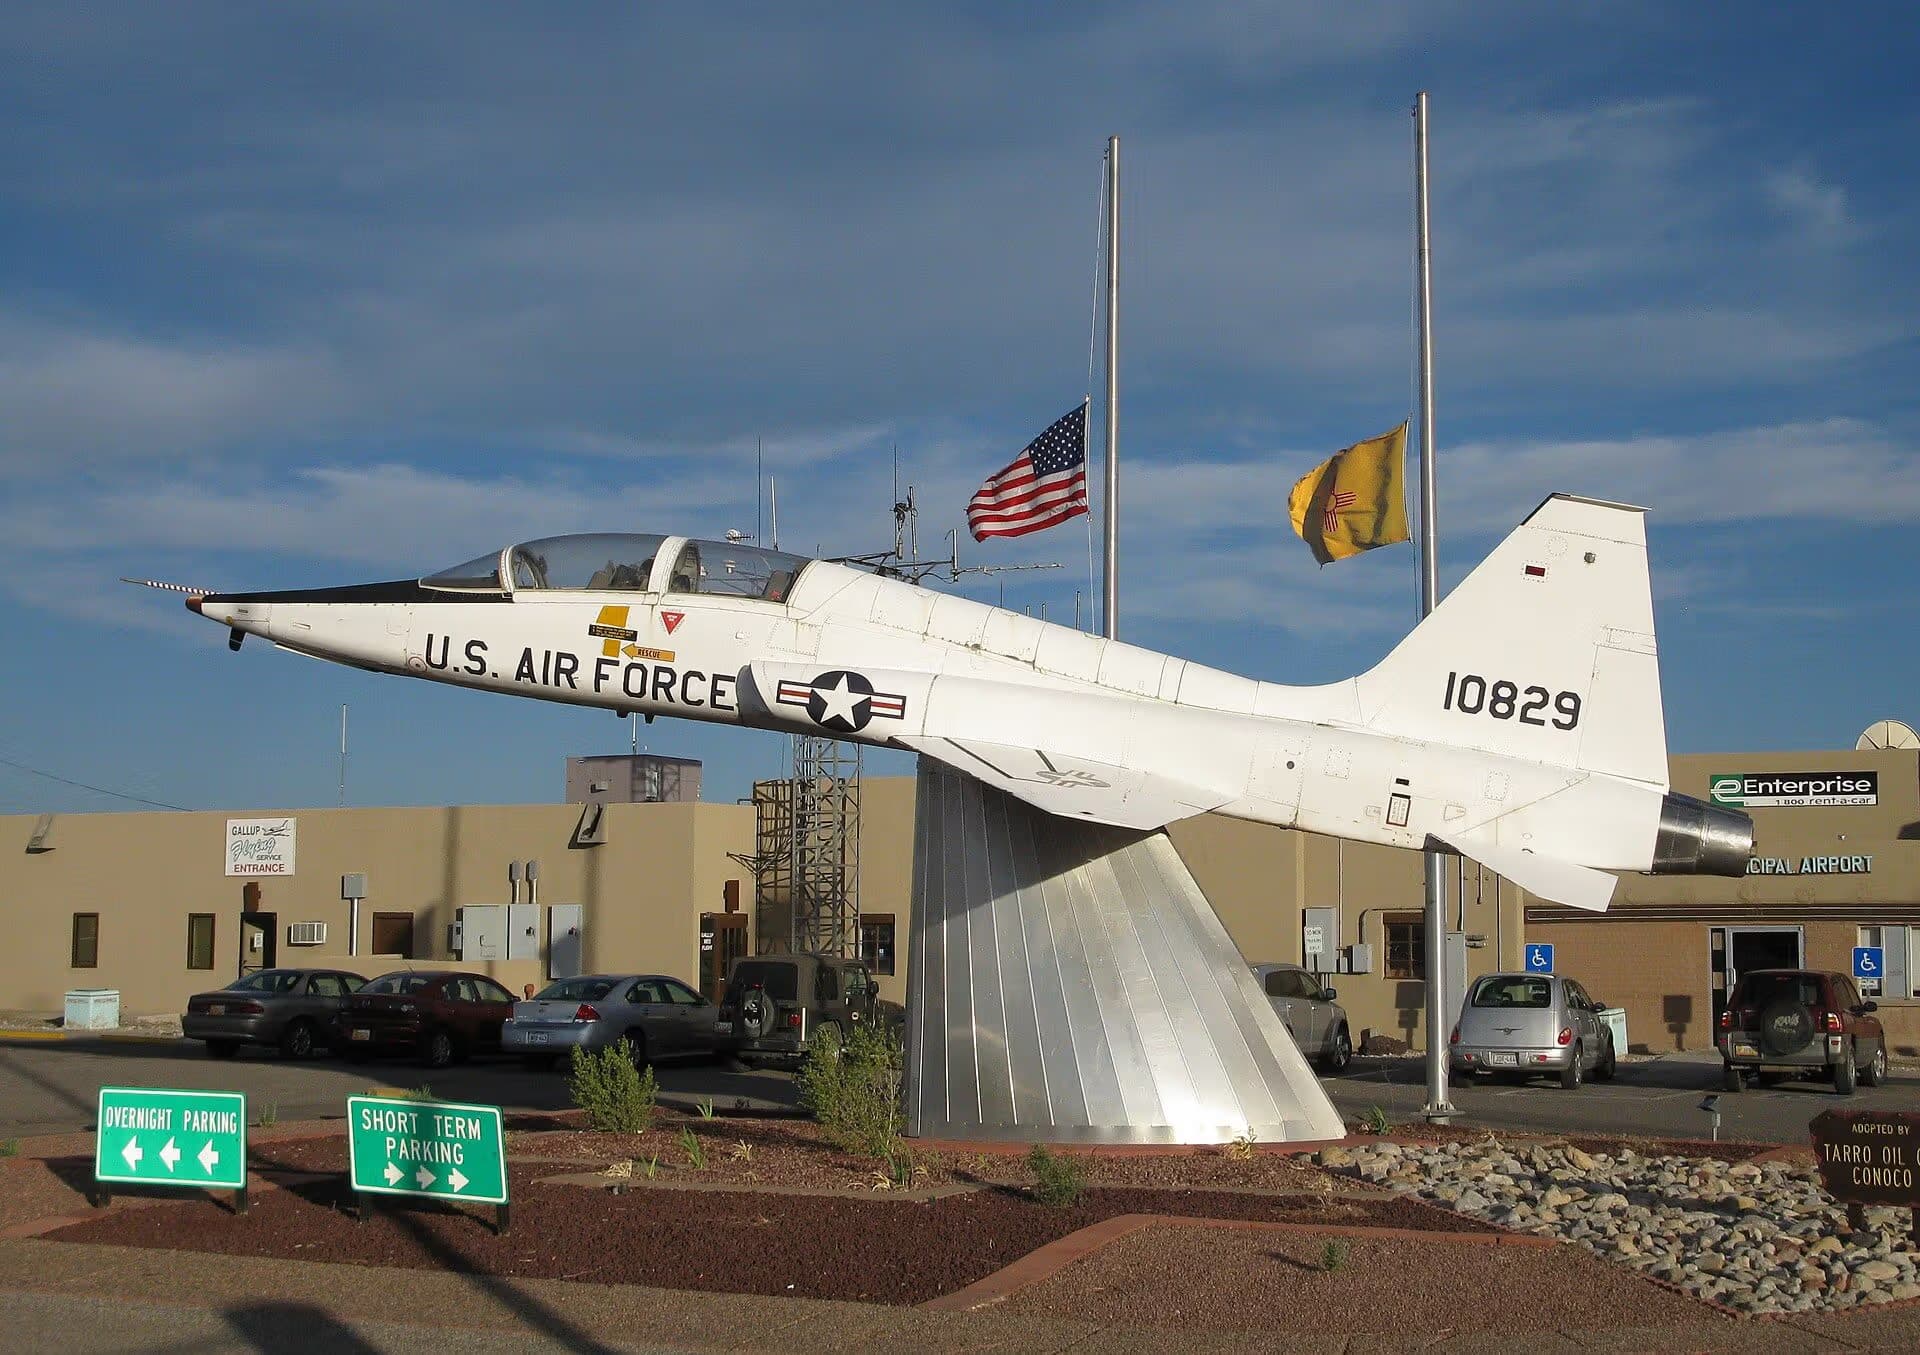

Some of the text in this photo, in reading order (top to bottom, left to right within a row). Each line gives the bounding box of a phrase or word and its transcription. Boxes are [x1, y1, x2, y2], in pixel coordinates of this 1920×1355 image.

[637, 649, 661, 659] RESCUE
[425, 633, 736, 711] U.S. AIR FORCE
[1443, 671, 1582, 731] 10829
[1744, 775, 1872, 796] Enterprise
[232, 826, 260, 836] GALLUP
[231, 837, 276, 862] Flying
[234, 863, 285, 873] ENTRANCE
[1800, 856, 1872, 873] AIRPORT
[106, 1106, 237, 1134] OVERNIGHT PARKING
[361, 1108, 481, 1140] SHORT TERM
[1852, 1123, 1910, 1136] ADOPTED BY
[385, 1136, 464, 1165] PARKING
[1823, 1143, 1872, 1163] TARRO
[1882, 1146, 1905, 1166] OIL
[1852, 1166, 1912, 1188] CONOCO
